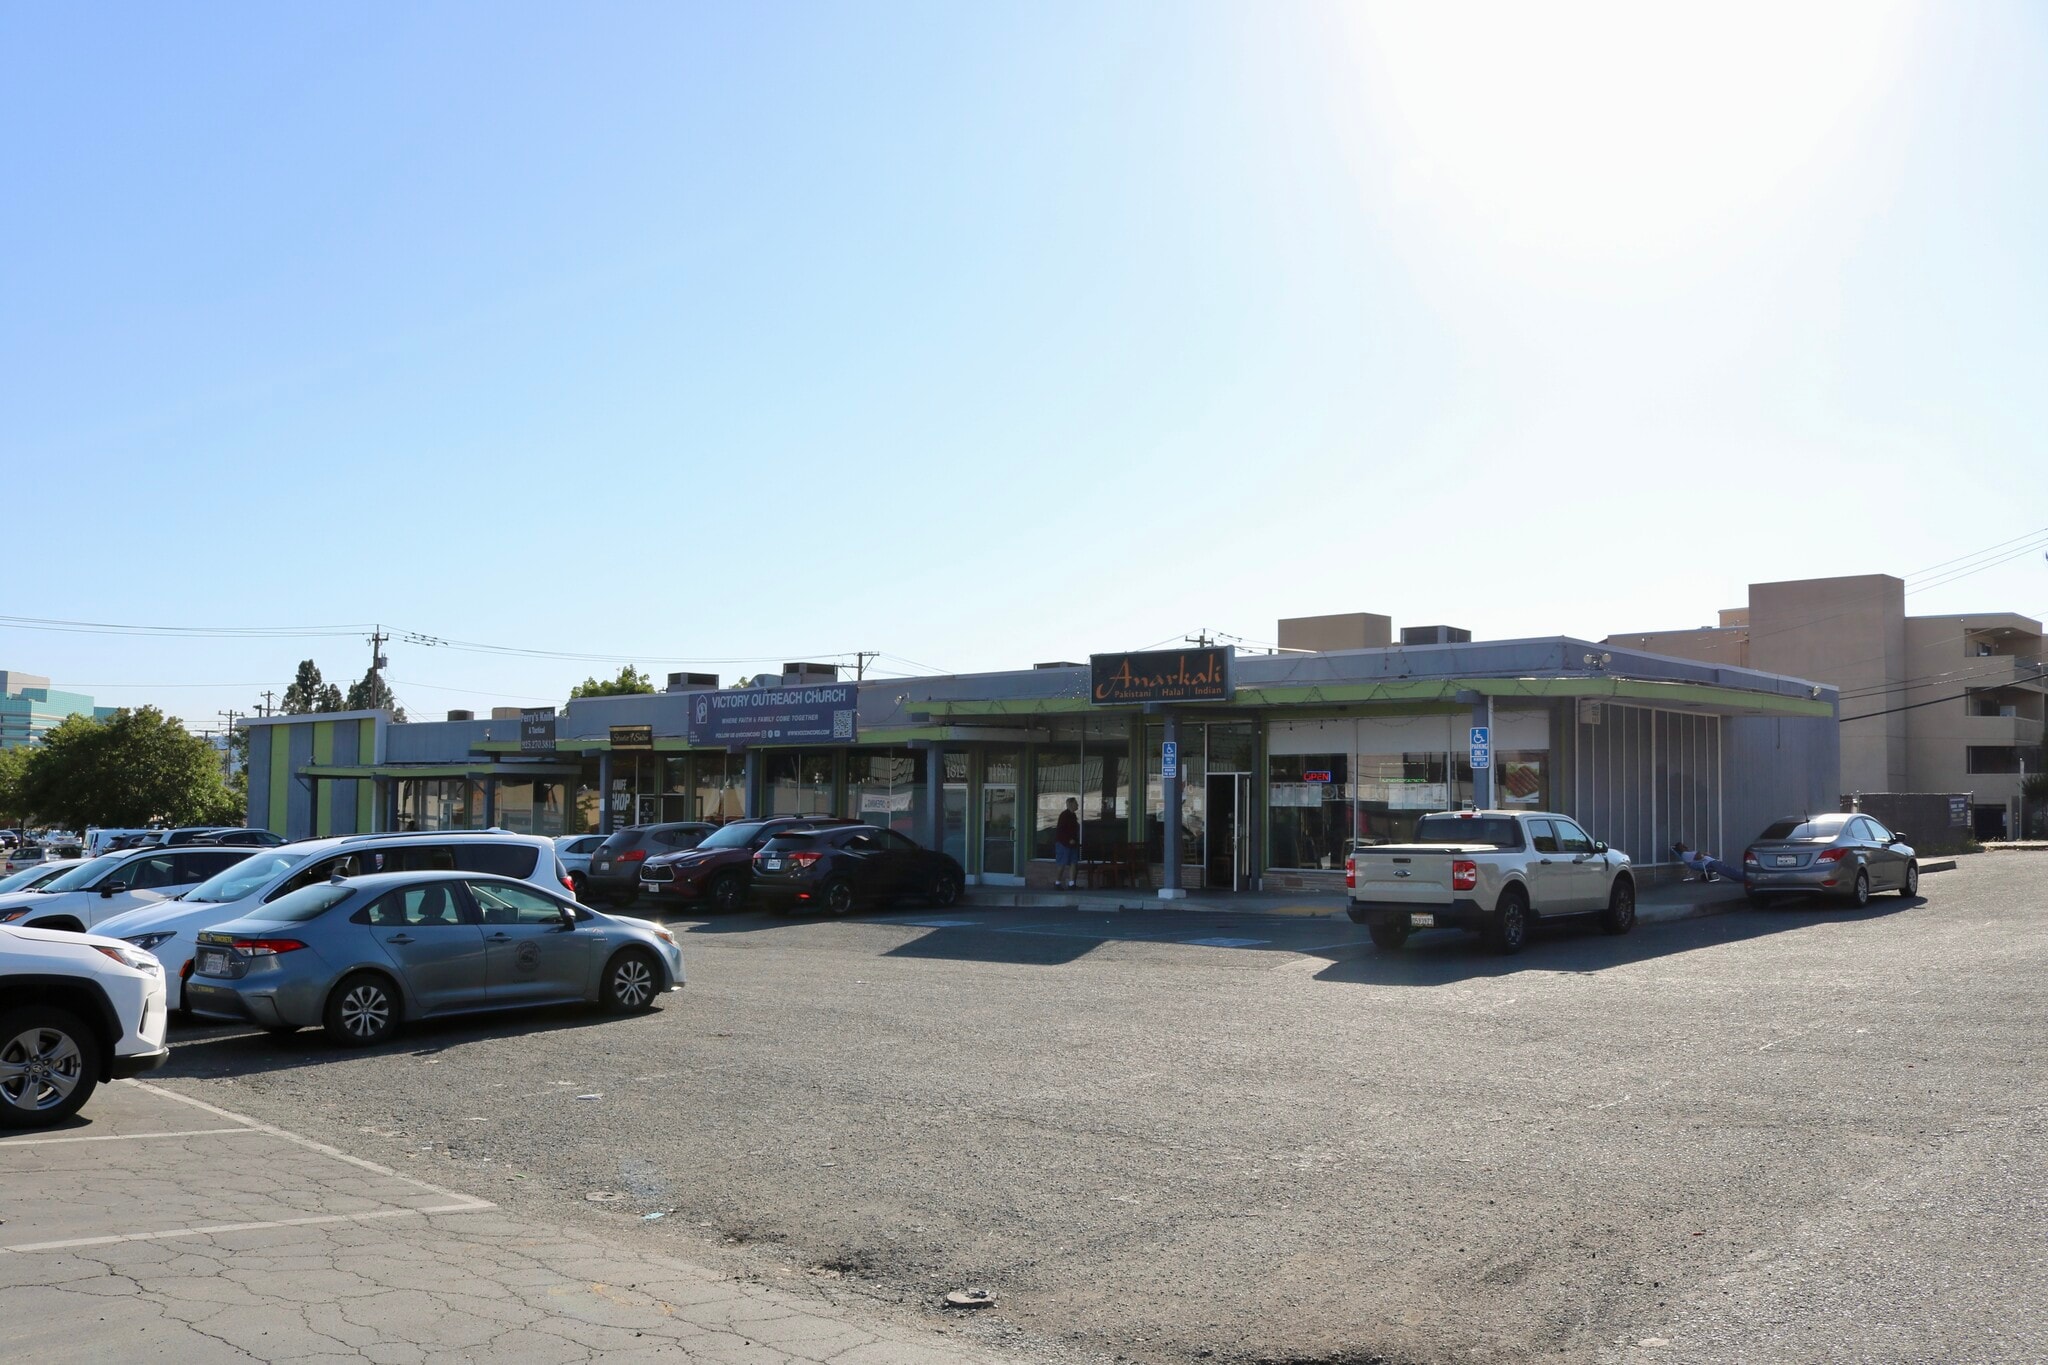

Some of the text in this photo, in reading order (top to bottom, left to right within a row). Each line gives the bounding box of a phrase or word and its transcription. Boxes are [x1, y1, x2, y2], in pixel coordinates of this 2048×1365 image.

[1096, 654, 1221, 698] Anarkali
[1114, 686, 1222, 698] Pakistani Halal Indian
[712, 688, 846, 709] VICTORY OUTREACH CHURCH
[791, 713, 819, 722] TOGETHER
[1303, 773, 1328, 781] OPEN
